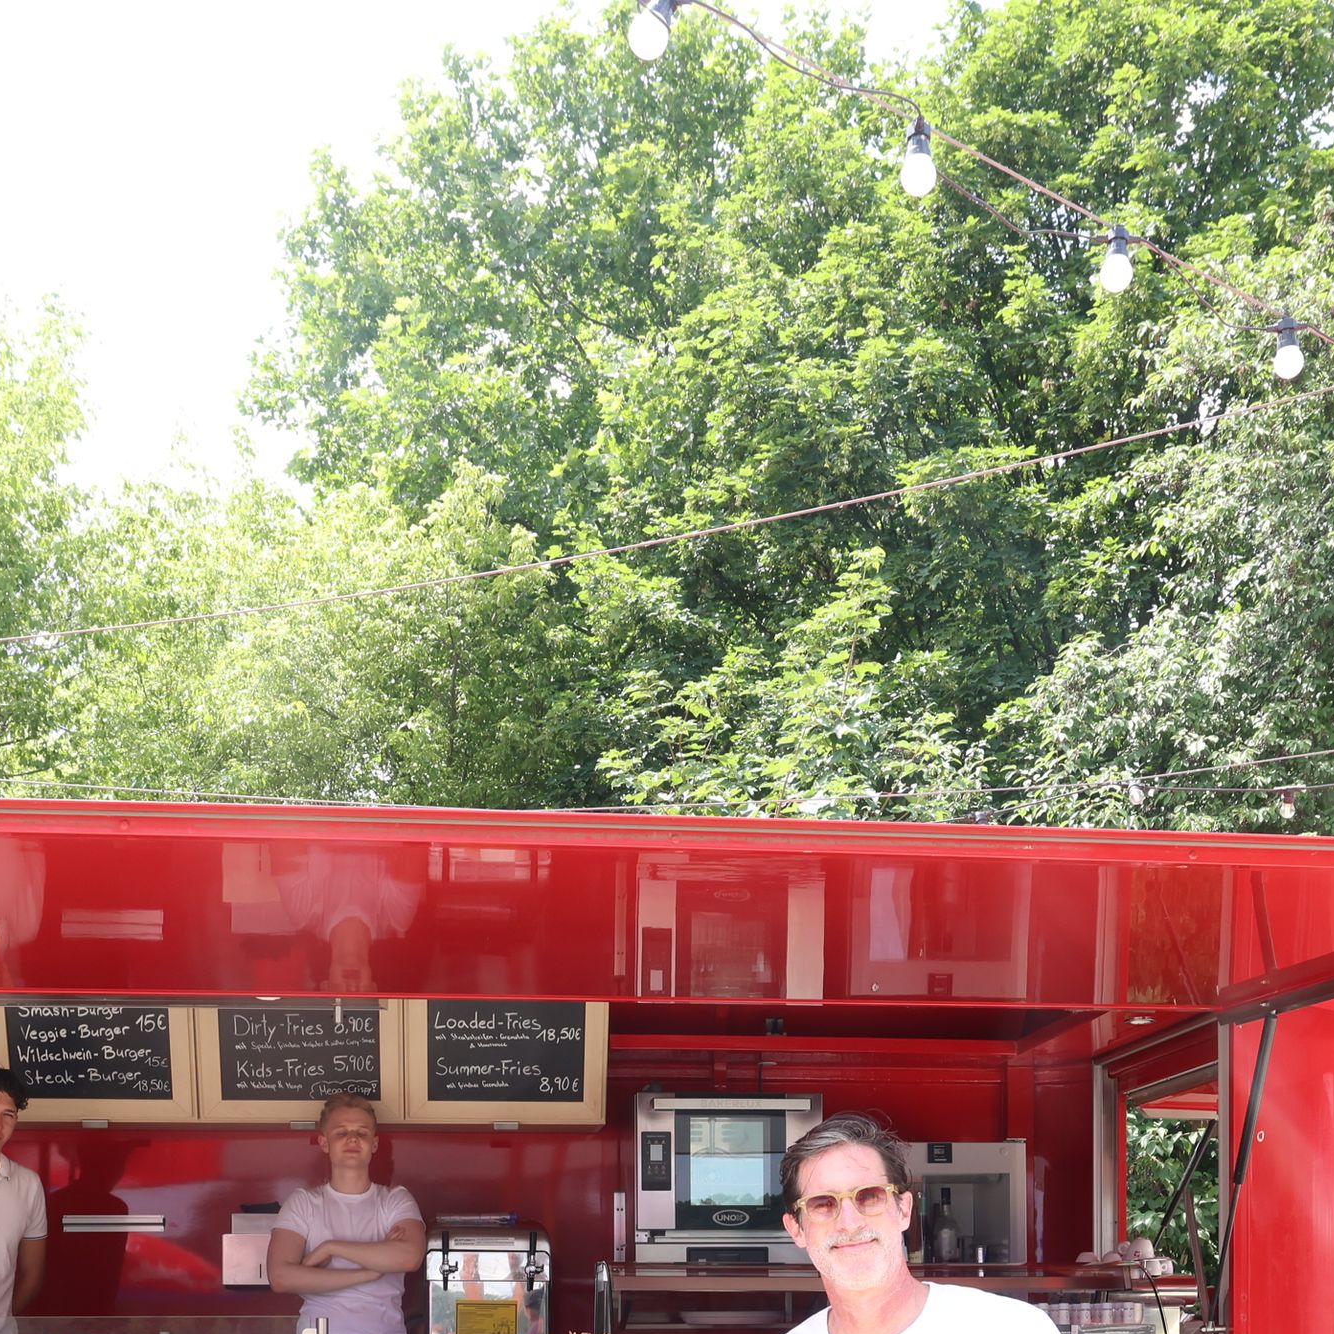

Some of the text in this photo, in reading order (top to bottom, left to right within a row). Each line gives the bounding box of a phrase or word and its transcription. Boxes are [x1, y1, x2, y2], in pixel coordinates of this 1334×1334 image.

[18, 1006, 124, 1020] Smash-Burger
[135, 1014, 167, 1033] 15€
[434, 1011, 581, 1043] Loaded-Fries 18,50€
[144, 1056, 169, 1068] 15€
[333, 1055, 375, 1072] 5,90€
[436, 1056, 579, 1094] Summer-Fries 8,90€
[133, 1079, 171, 1093] 18,50€
